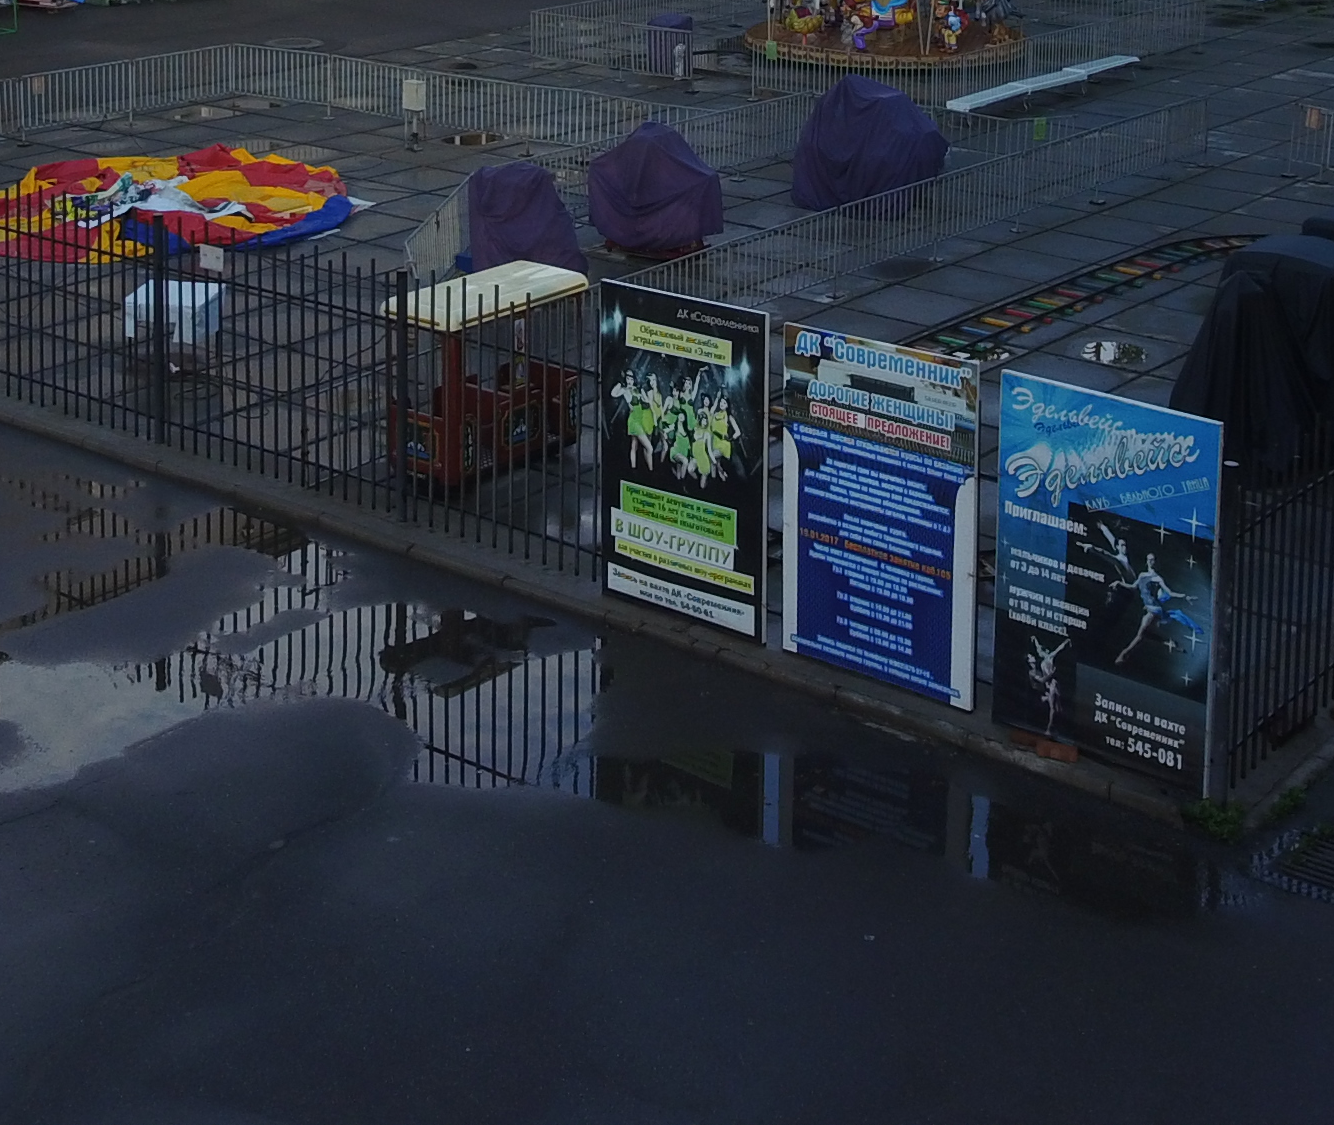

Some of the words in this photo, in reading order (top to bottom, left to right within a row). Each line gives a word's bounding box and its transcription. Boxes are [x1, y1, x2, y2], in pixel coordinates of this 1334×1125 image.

[677, 307, 688, 320] ДК
[796, 331, 819, 357] ДК
[809, 380, 868, 407] ДОРОГИЕ
[1011, 387, 1124, 433] Эдельвейс
[811, 402, 858, 425] СТОЯЩЕЕ
[867, 416, 949, 449] ПРЕДЛОЖЕНИЕ!
[1005, 437, 1201, 507] Эдельвейс
[1004, 499, 1087, 539] Приглашаем:
[615, 517, 623, 533] В
[628, 521, 729, 566] ШОУ-ГРУППУ
[799, 527, 838, 546] 19.01.2017
[1010, 546, 1058, 568] мальчиков
[1059, 561, 1065, 570] и
[1010, 558, 1020, 569] от
[1021, 561, 1026, 572] 3
[1027, 563, 1039, 576] до
[1041, 567, 1049, 578] 14
[671, 587, 681, 598] ДК
[1045, 595, 1050, 604] и
[1008, 597, 1017, 607] от
[1019, 599, 1028, 611] 18
[1030, 604, 1044, 616] лет
[1046, 609, 1052, 618] и
[1053, 611, 1086, 631] старше
[1094, 692, 1133, 718] Запись
[1136, 709, 1150, 723] на
[1154, 715, 1185, 736] вахте
[1094, 708, 1107, 726] ДК
[1110, 713, 1185, 754] "Современник"
[1127, 735, 1182, 771] 545-081
